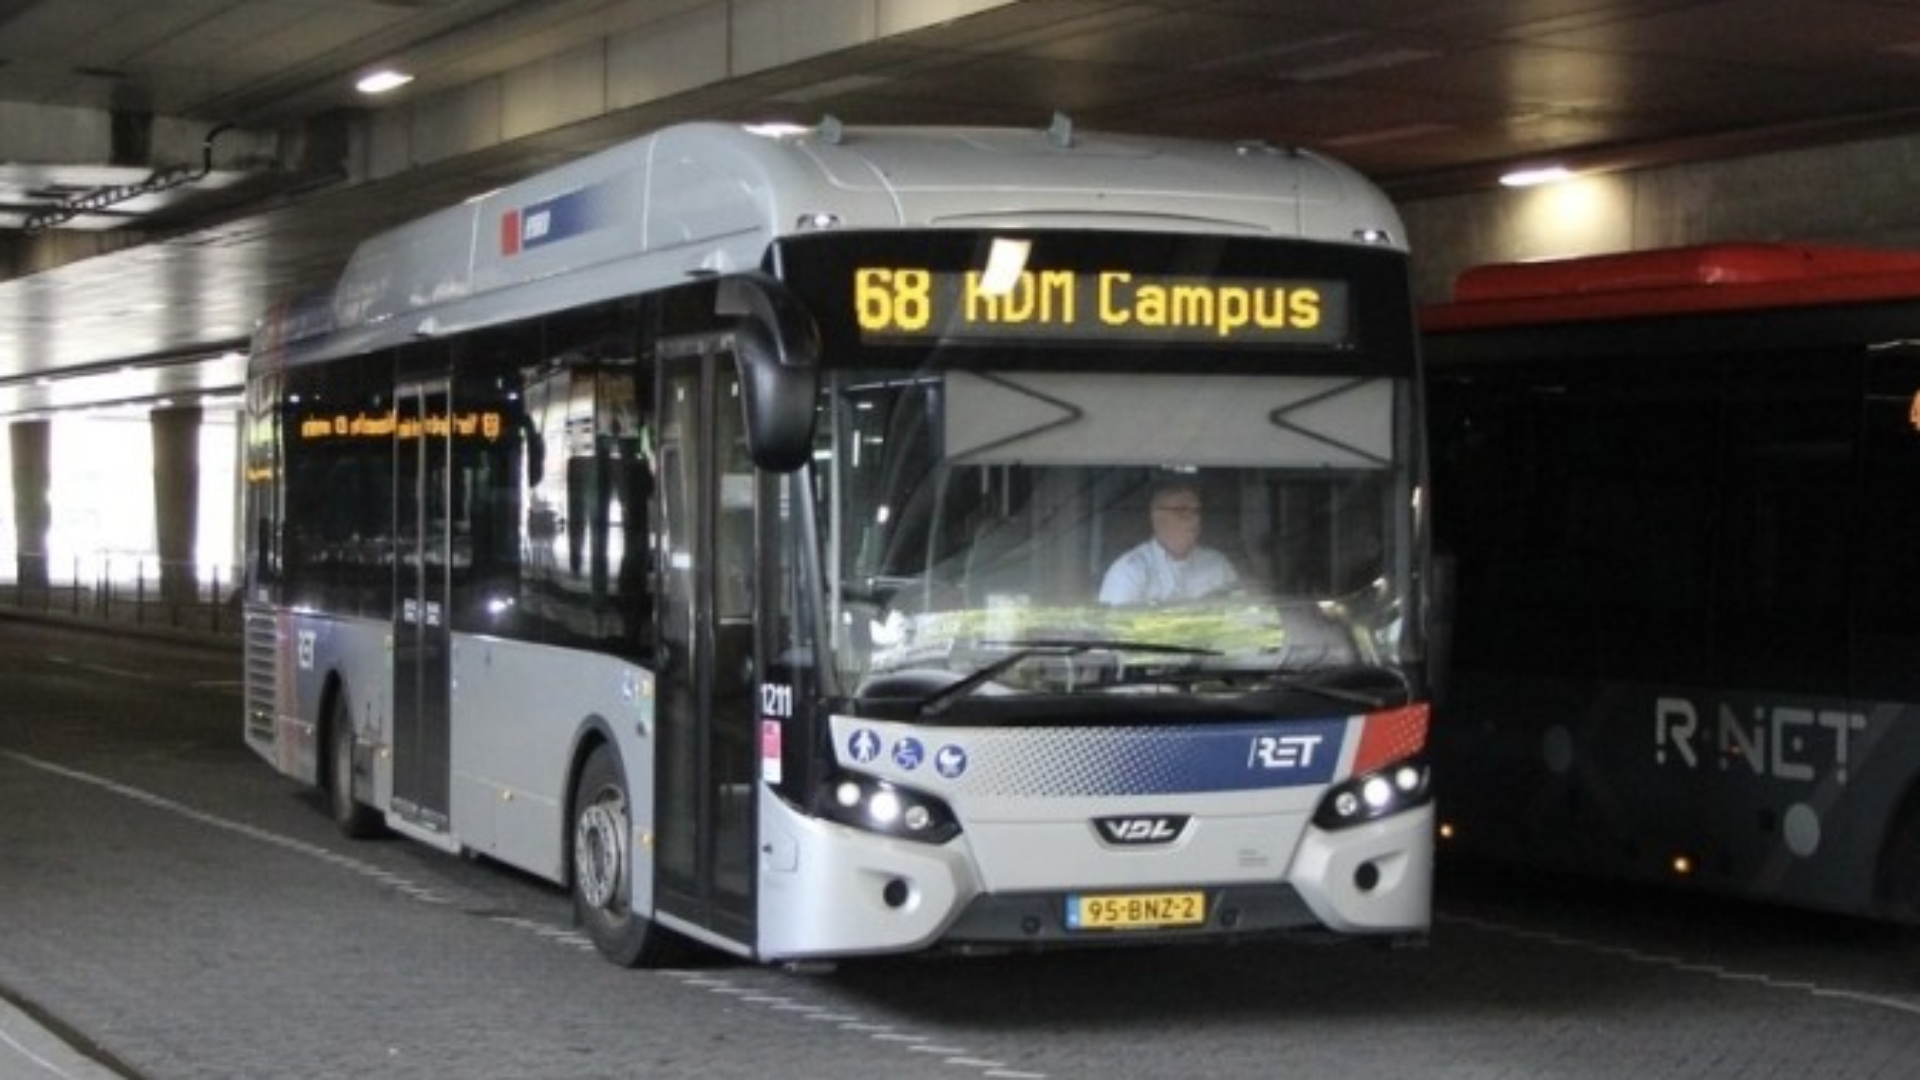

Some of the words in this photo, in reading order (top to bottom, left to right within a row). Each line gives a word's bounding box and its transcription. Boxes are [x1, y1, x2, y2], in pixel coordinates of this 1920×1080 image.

[856, 268, 930, 330] 68
[1099, 272, 1321, 336] Campus
[761, 683, 793, 717] 1211
[1247, 735, 1322, 769] RET
[1106, 819, 1176, 839] VDL
[1088, 896, 1195, 922] 95-BNZ-2
